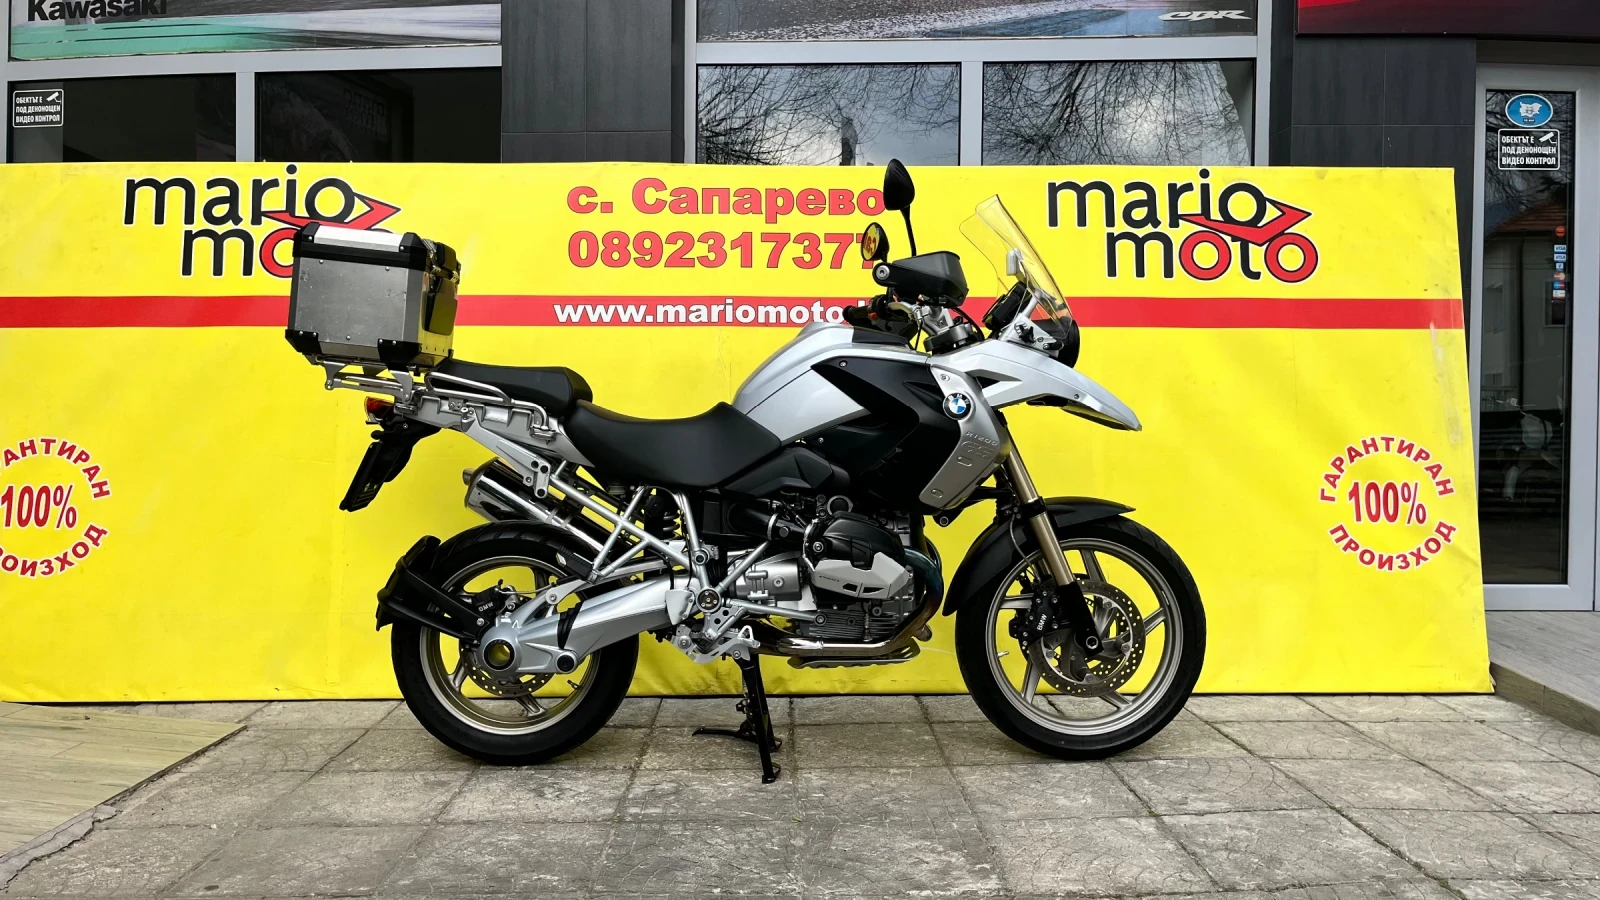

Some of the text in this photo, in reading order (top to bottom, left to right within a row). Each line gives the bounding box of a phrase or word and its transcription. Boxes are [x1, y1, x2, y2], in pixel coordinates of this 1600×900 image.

[27, 0, 167, 22] Kawasaki
[15, 106, 28, 114] ПОД
[15, 114, 60, 123] ВИДЕО КОНТРОЛ
[1501, 135, 1530, 144] ОБЕКТЪТ
[1501, 146, 1557, 155] ПОД ДЕНОНОЩЕН
[1501, 156, 1556, 165] ВИДЕО КОНТРОЛ
[124, 163, 355, 226] mario
[631, 177, 886, 224] Сапарево
[1048, 168, 1267, 229] mario
[181, 227, 294, 278] mo
[1106, 229, 1319, 283] moto
[0, 438, 110, 498] АНТИРАН
[1320, 436, 1455, 502] ГАРАНТИРАН
[1, 484, 77, 529] 100%
[1348, 481, 1427, 525] 100%
[0, 524, 108, 577] ОИЗХОД
[1329, 521, 1457, 571] ПРОИЗХОД
[1036, 613, 1048, 631] BMW
